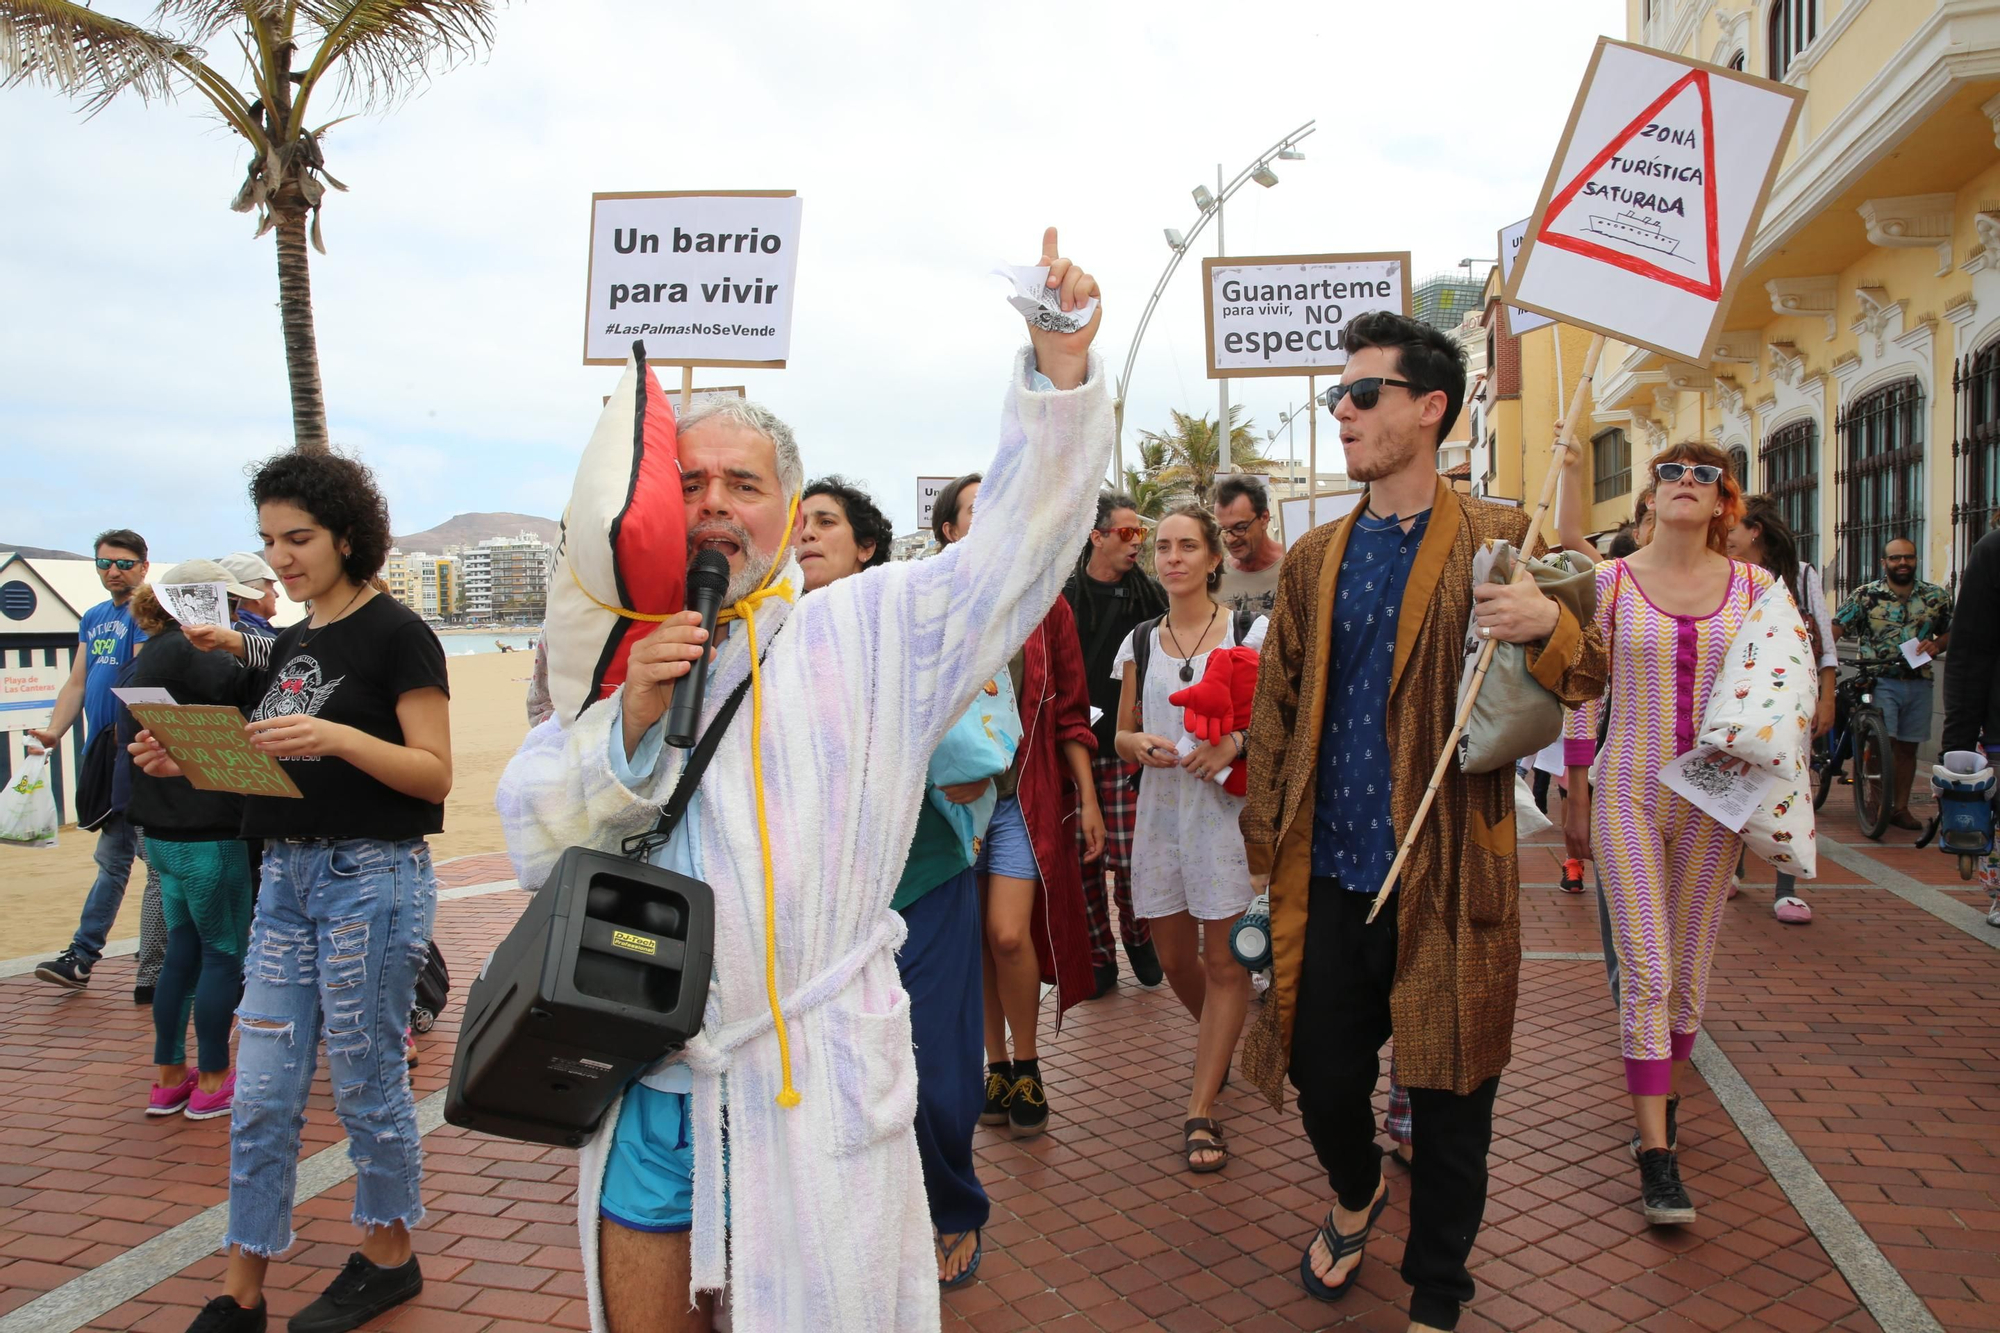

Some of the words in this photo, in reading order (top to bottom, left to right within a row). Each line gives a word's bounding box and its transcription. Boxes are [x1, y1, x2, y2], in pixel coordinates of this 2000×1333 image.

[1640, 124, 1695, 149] ZONA
[1611, 155, 1702, 186] TURÍSTICA
[1582, 181, 1685, 218] SATURADA
[614, 228, 659, 254] Un
[672, 227, 782, 254] barrio
[609, 283, 688, 310] para
[701, 277, 778, 304] vivir
[1222, 280, 1391, 303] Guanarteme
[1222, 306, 1254, 319] para
[1258, 303, 1293, 317] vivir,
[1305, 304, 1343, 325] NO
[605, 323, 776, 337] #LasPalmasNoSeVende
[1224, 329, 1345, 360] especu
[4, 676, 26, 685] Playa
[28, 675, 38, 683] de
[20, 684, 56, 693] Canteras
[136, 710, 184, 726] YOUR
[178, 711, 243, 729] LUXURY
[169, 745, 218, 765] OUR
[215, 748, 271, 771] DAILY
[200, 765, 290, 793] MISERY
